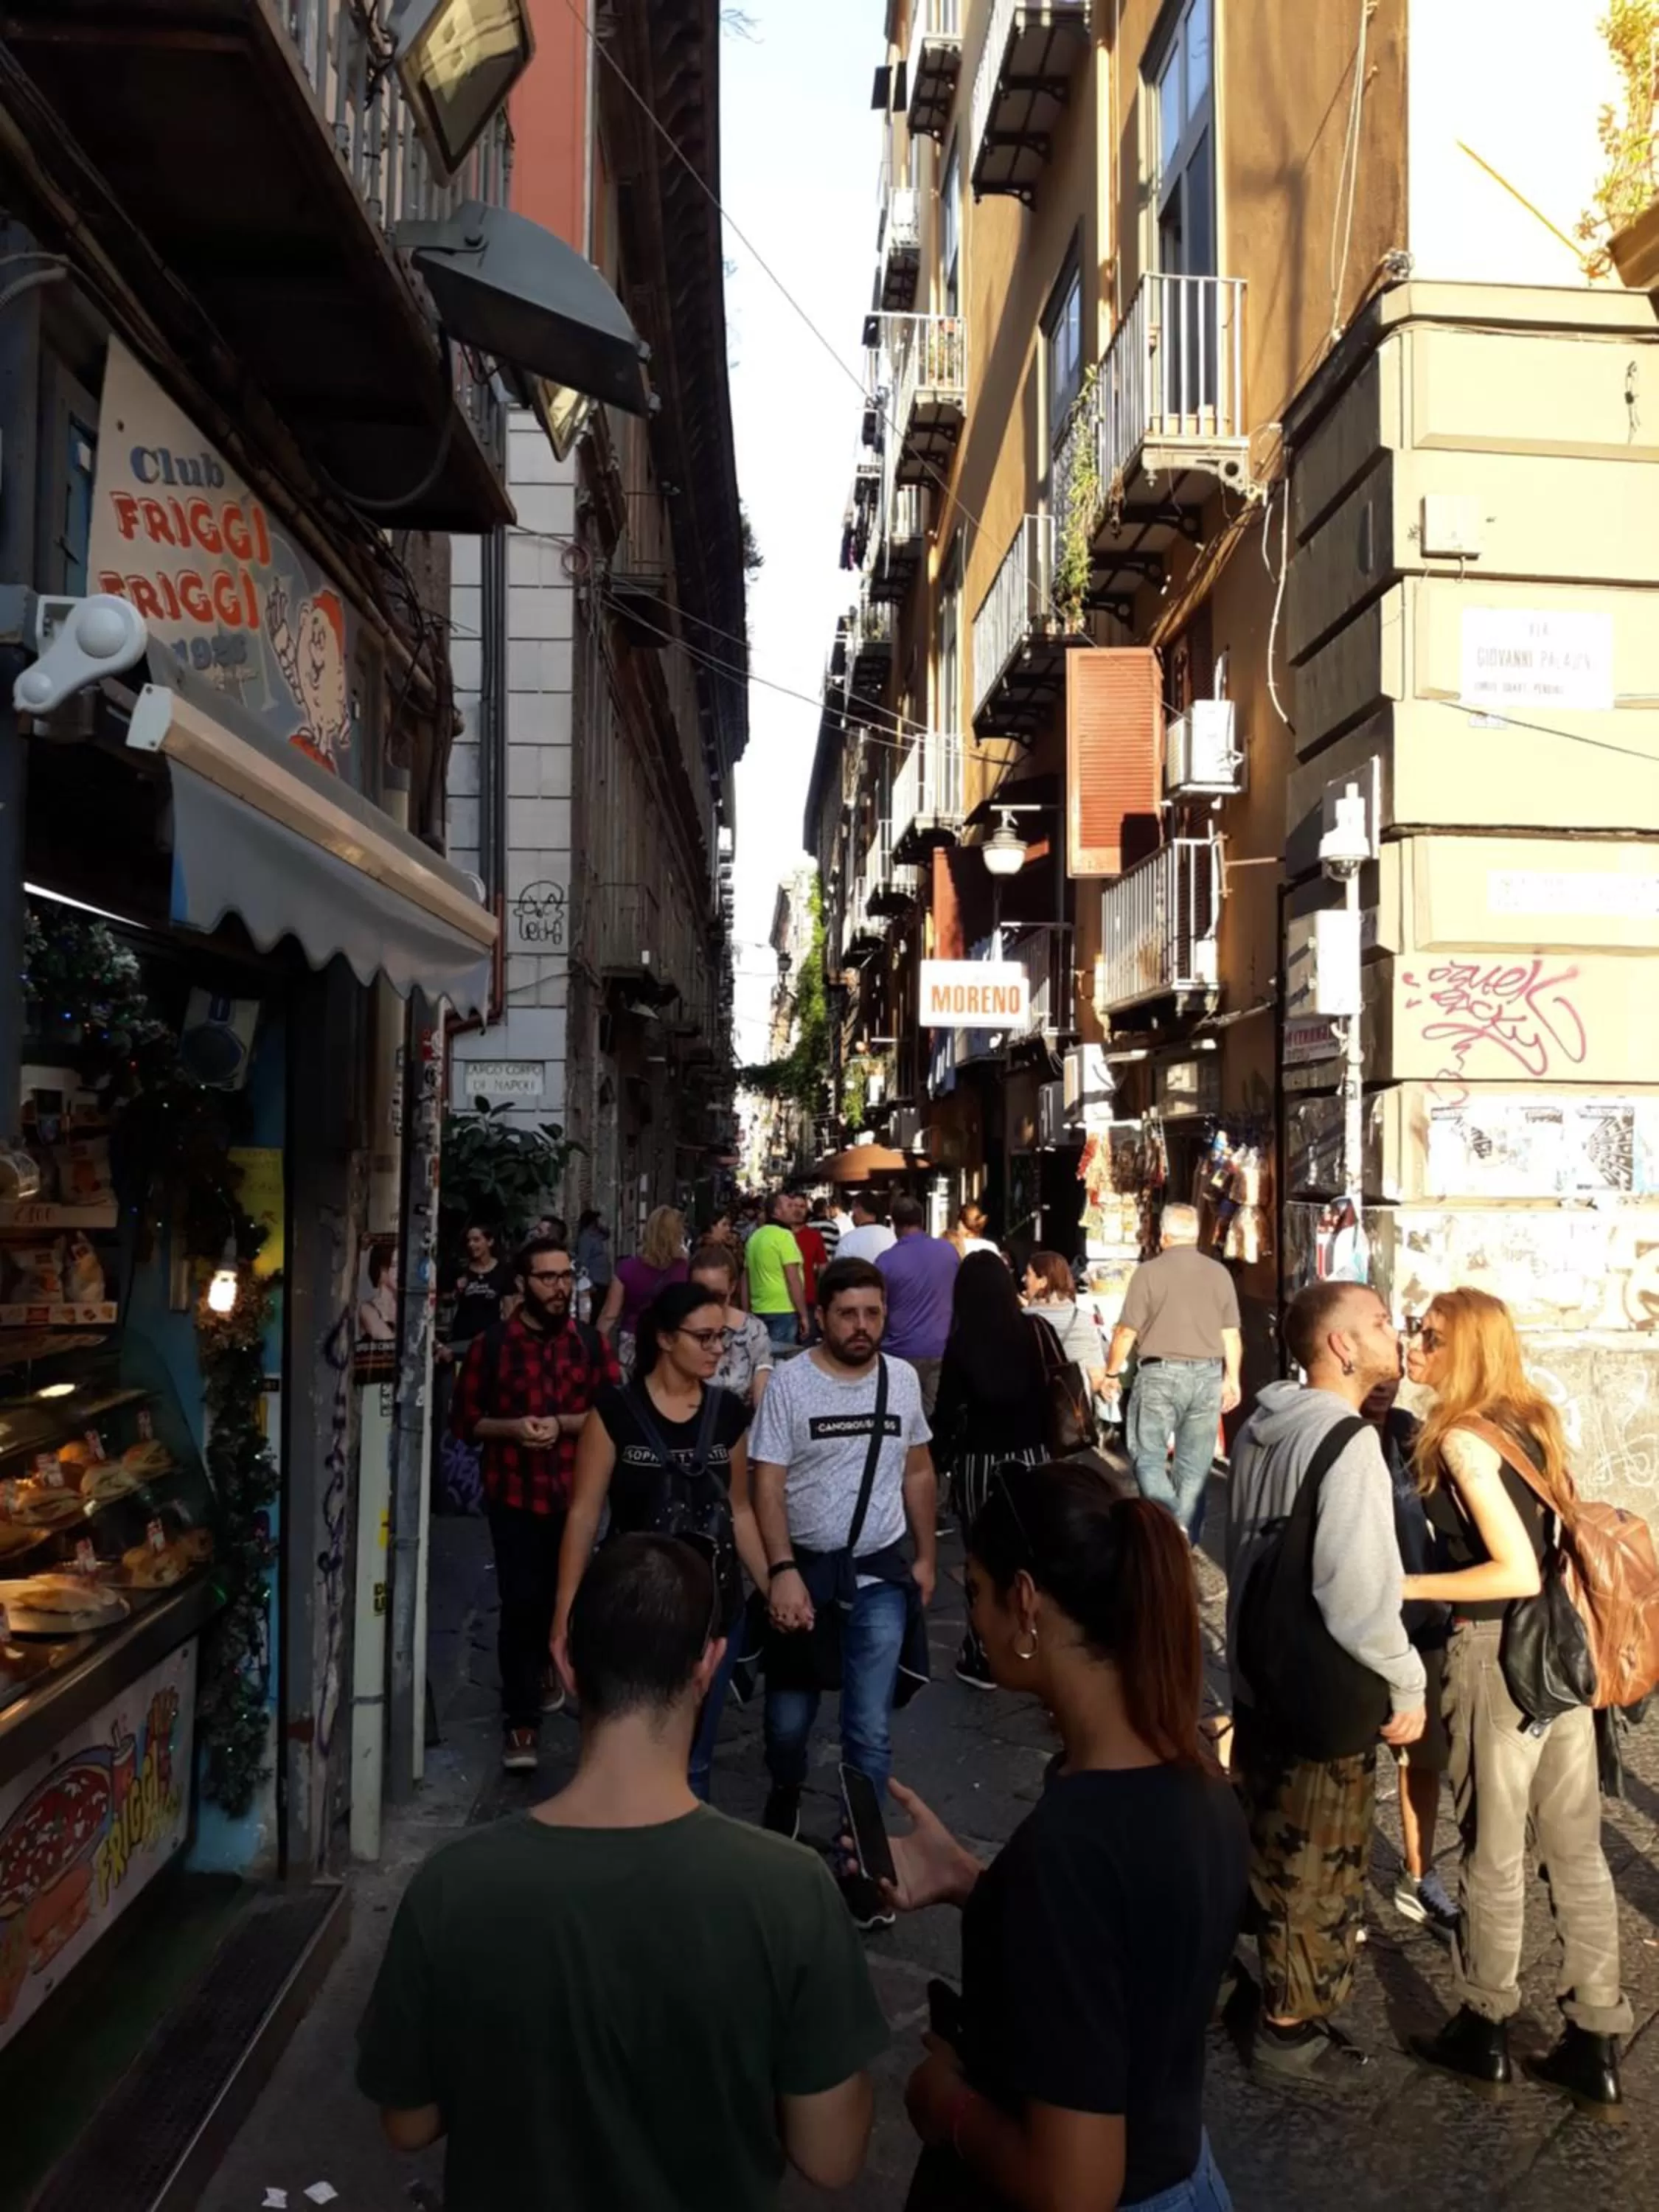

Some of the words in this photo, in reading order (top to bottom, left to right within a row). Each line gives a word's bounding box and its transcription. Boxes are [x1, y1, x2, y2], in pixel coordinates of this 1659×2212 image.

[130, 445, 225, 489] Club
[109, 490, 271, 566] FRIGGI
[931, 984, 1021, 1014] MORENO
[495, 1079, 534, 1091] NAPOLI
